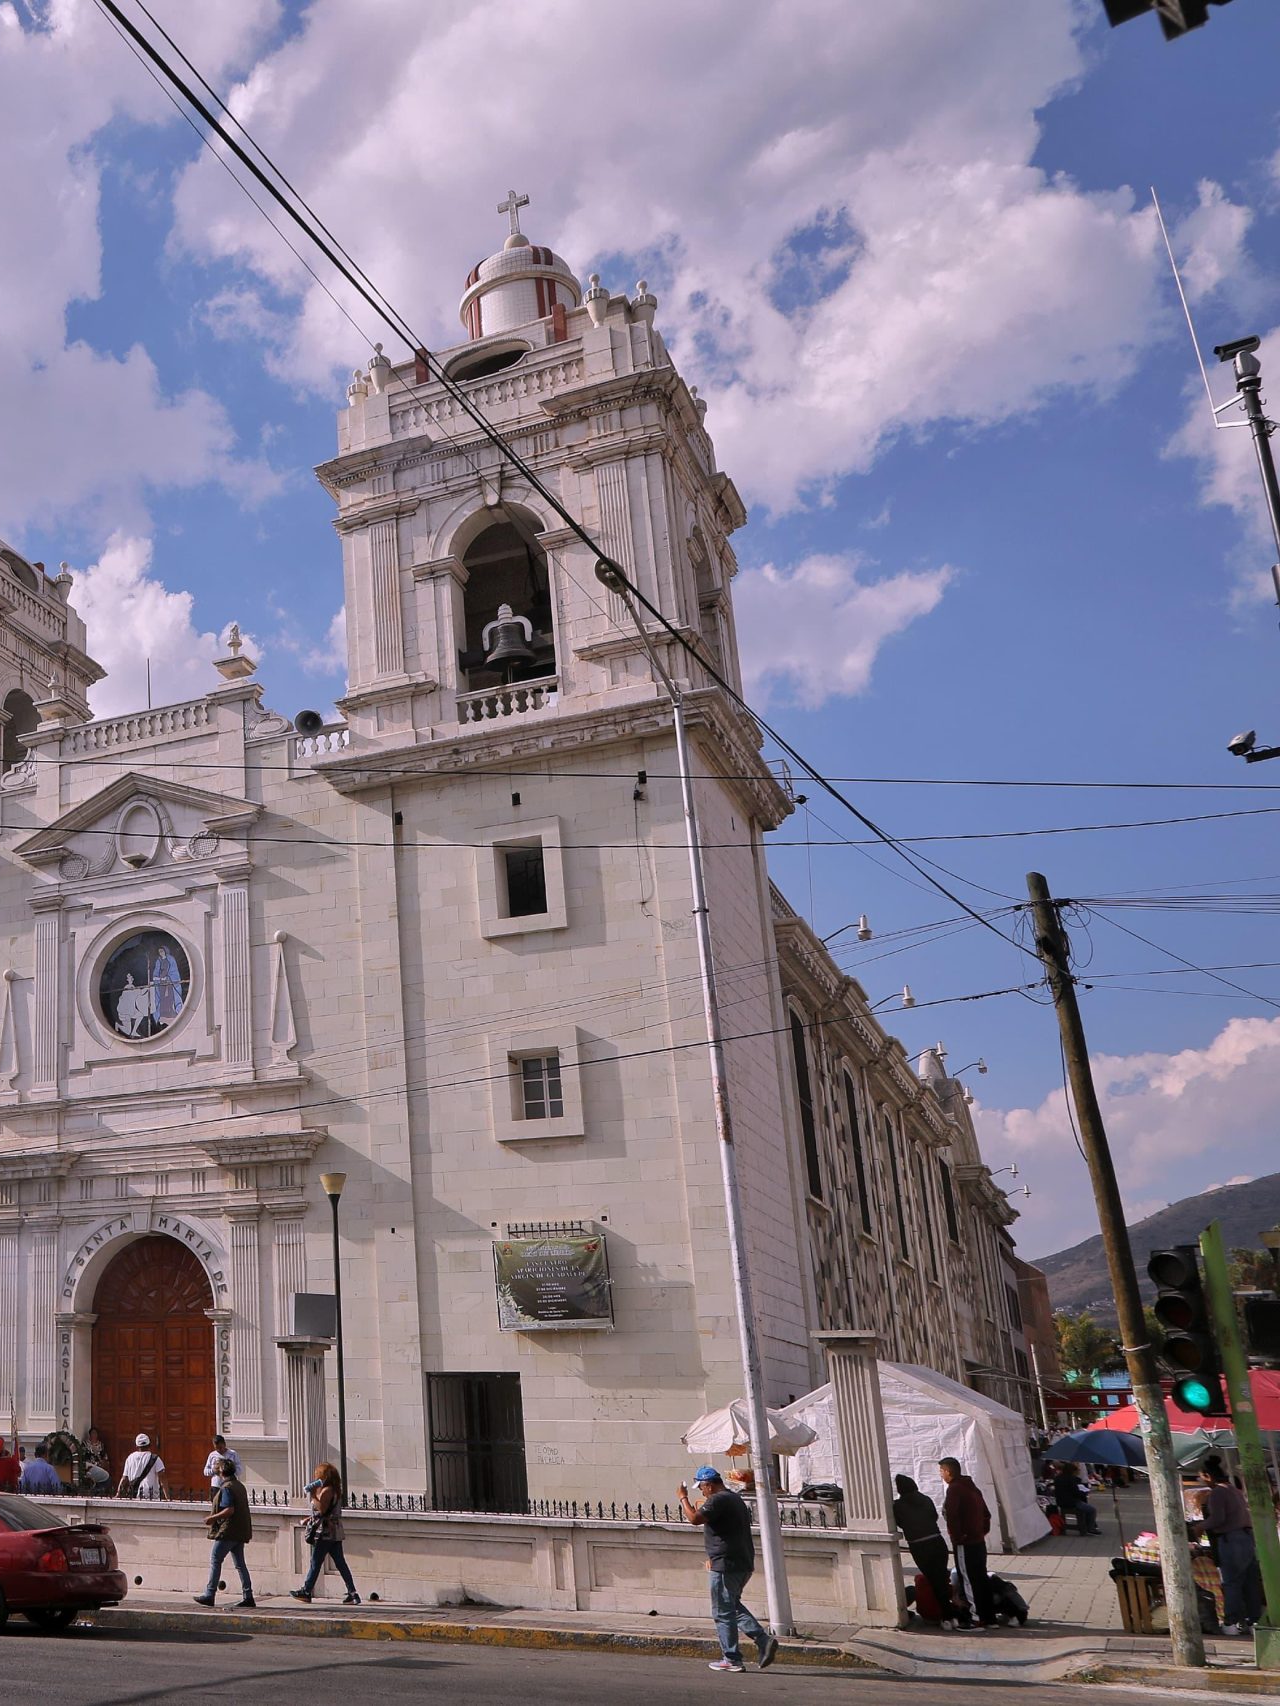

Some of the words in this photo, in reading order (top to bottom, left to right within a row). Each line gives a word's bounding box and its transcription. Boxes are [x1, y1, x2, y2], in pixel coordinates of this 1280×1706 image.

[63, 1277, 77, 1298] DE
[76, 1219, 128, 1267] SANTA
[158, 1216, 213, 1262] MARIA
[213, 1270, 228, 1294] DE
[60, 1332, 70, 1431] BASILICA
[220, 1329, 232, 1434] GUADALUPE
